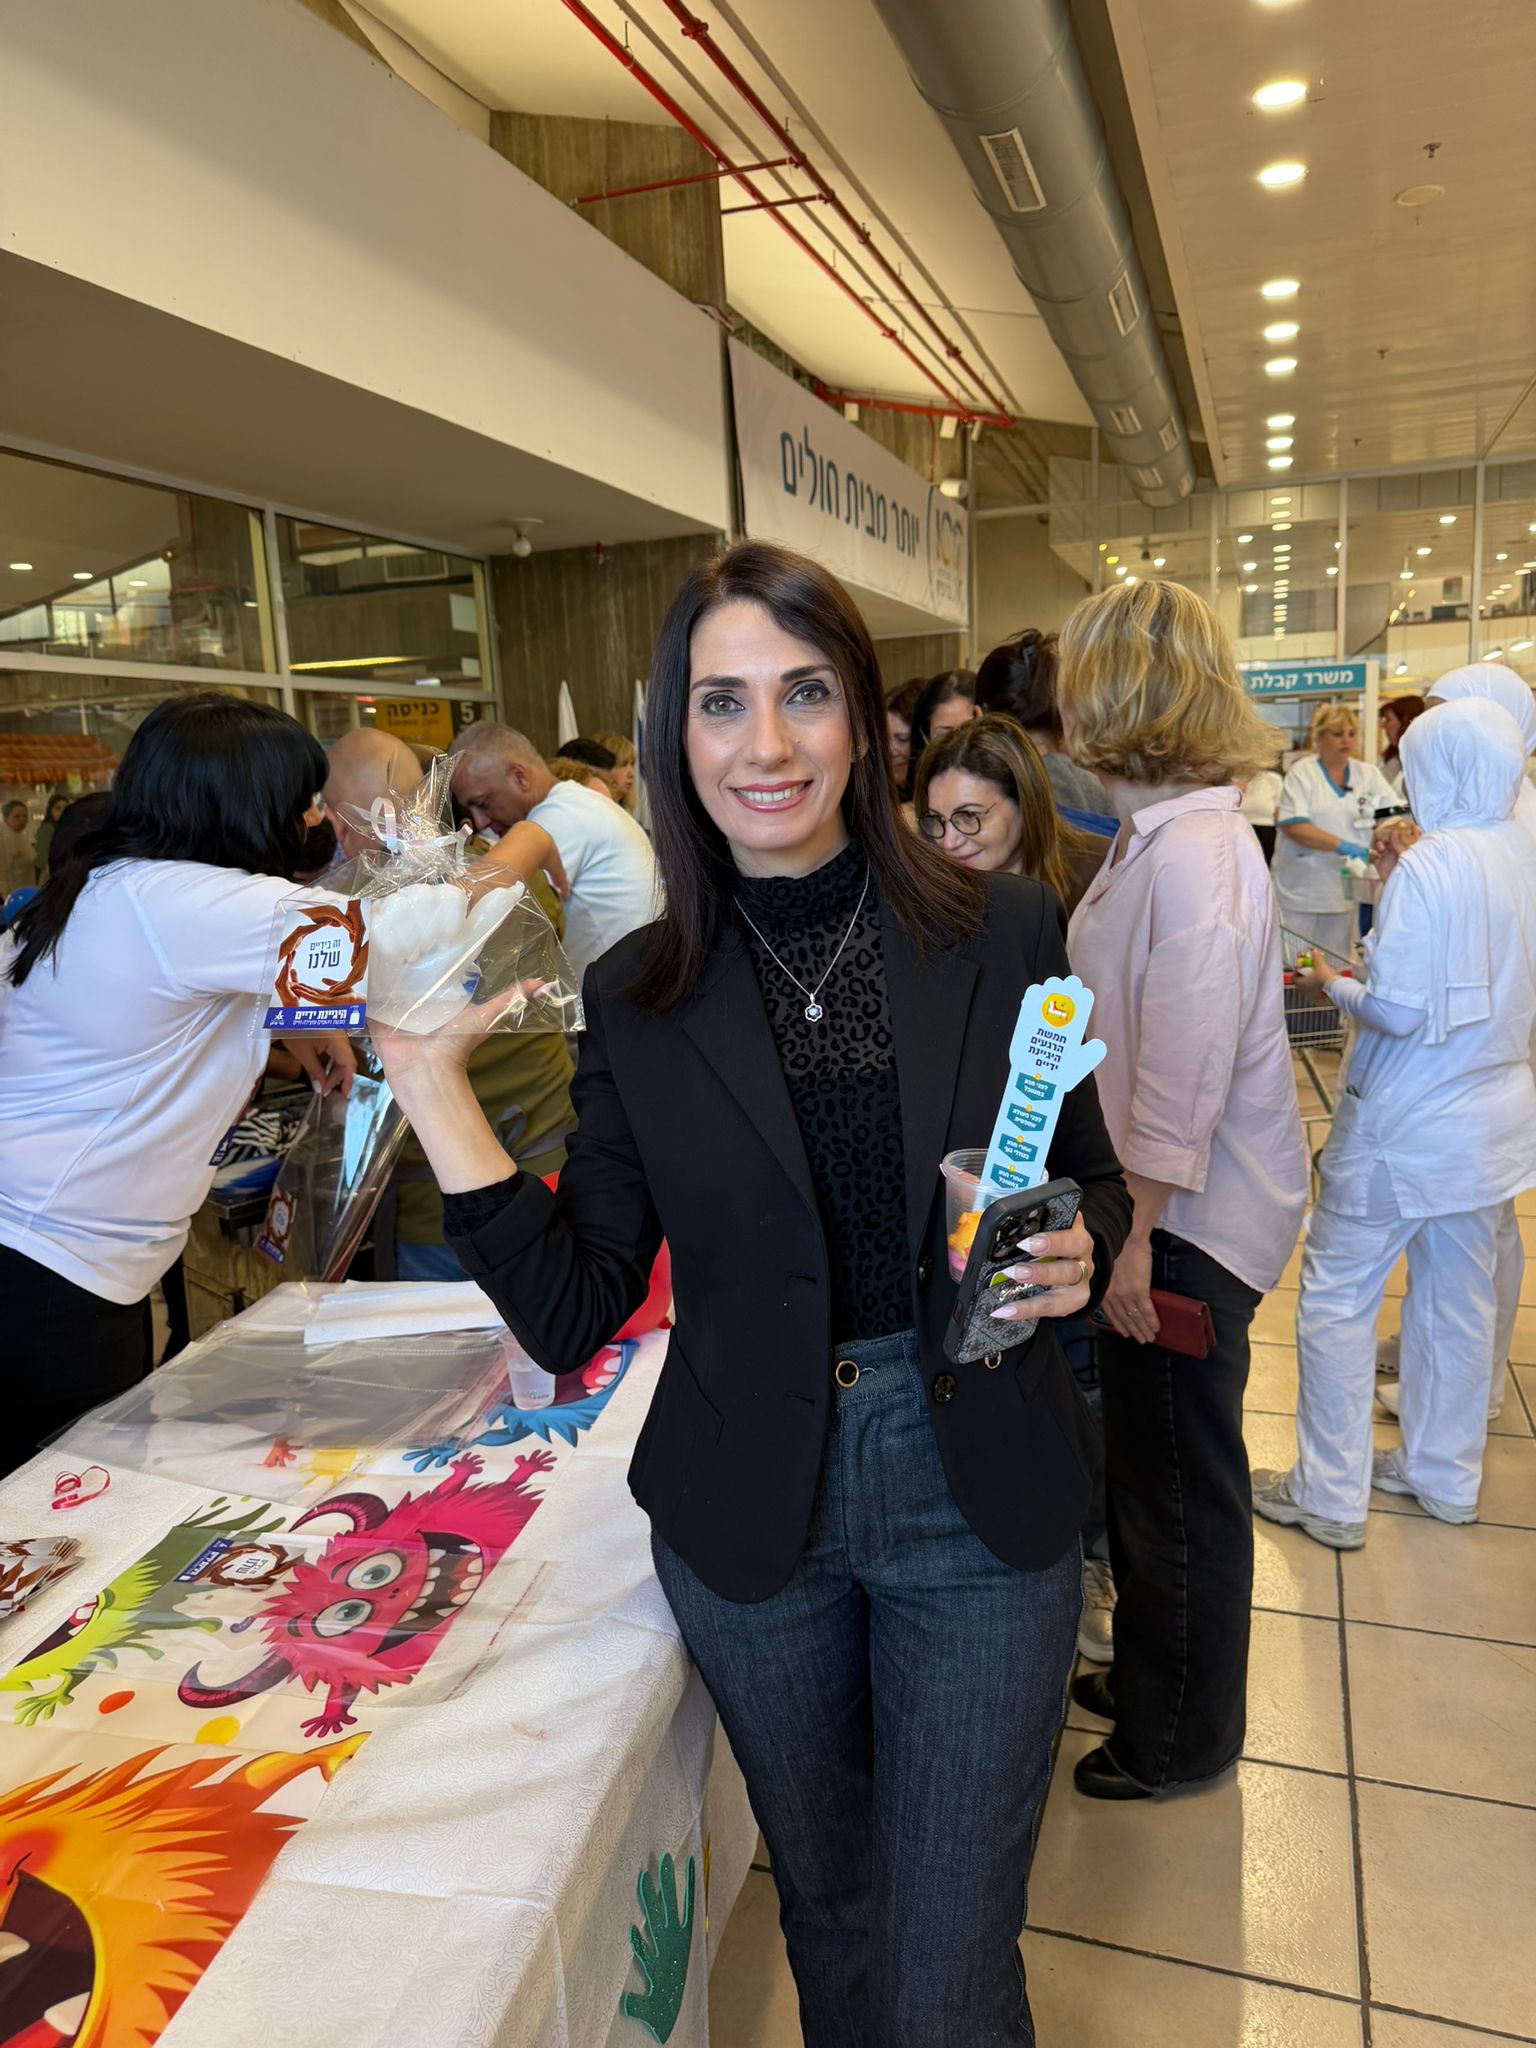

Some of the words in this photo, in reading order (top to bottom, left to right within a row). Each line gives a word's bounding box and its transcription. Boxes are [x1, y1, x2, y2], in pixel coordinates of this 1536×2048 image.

[780, 424, 839, 519] חולים
[845, 473, 887, 543] מבית
[891, 501, 919, 558] יותר
[1250, 672, 1298, 690] קבלת
[1302, 669, 1353, 686] משרד
[387, 702, 439, 717] כניסה
[461, 702, 474, 723] 5
[310, 940, 331, 951] בידיים
[333, 939, 341, 948] זה
[308, 949, 341, 969] שלנו
[295, 1011, 316, 1019] ידיים
[317, 1010, 347, 1019] היגיינת
[1036, 1028, 1067, 1044] חמשת
[1031, 1036, 1064, 1053] הרגעים
[1028, 1046, 1062, 1062] היגיינת
[1035, 1059, 1058, 1070] ידיים
[1036, 1082, 1048, 1091] לפני
